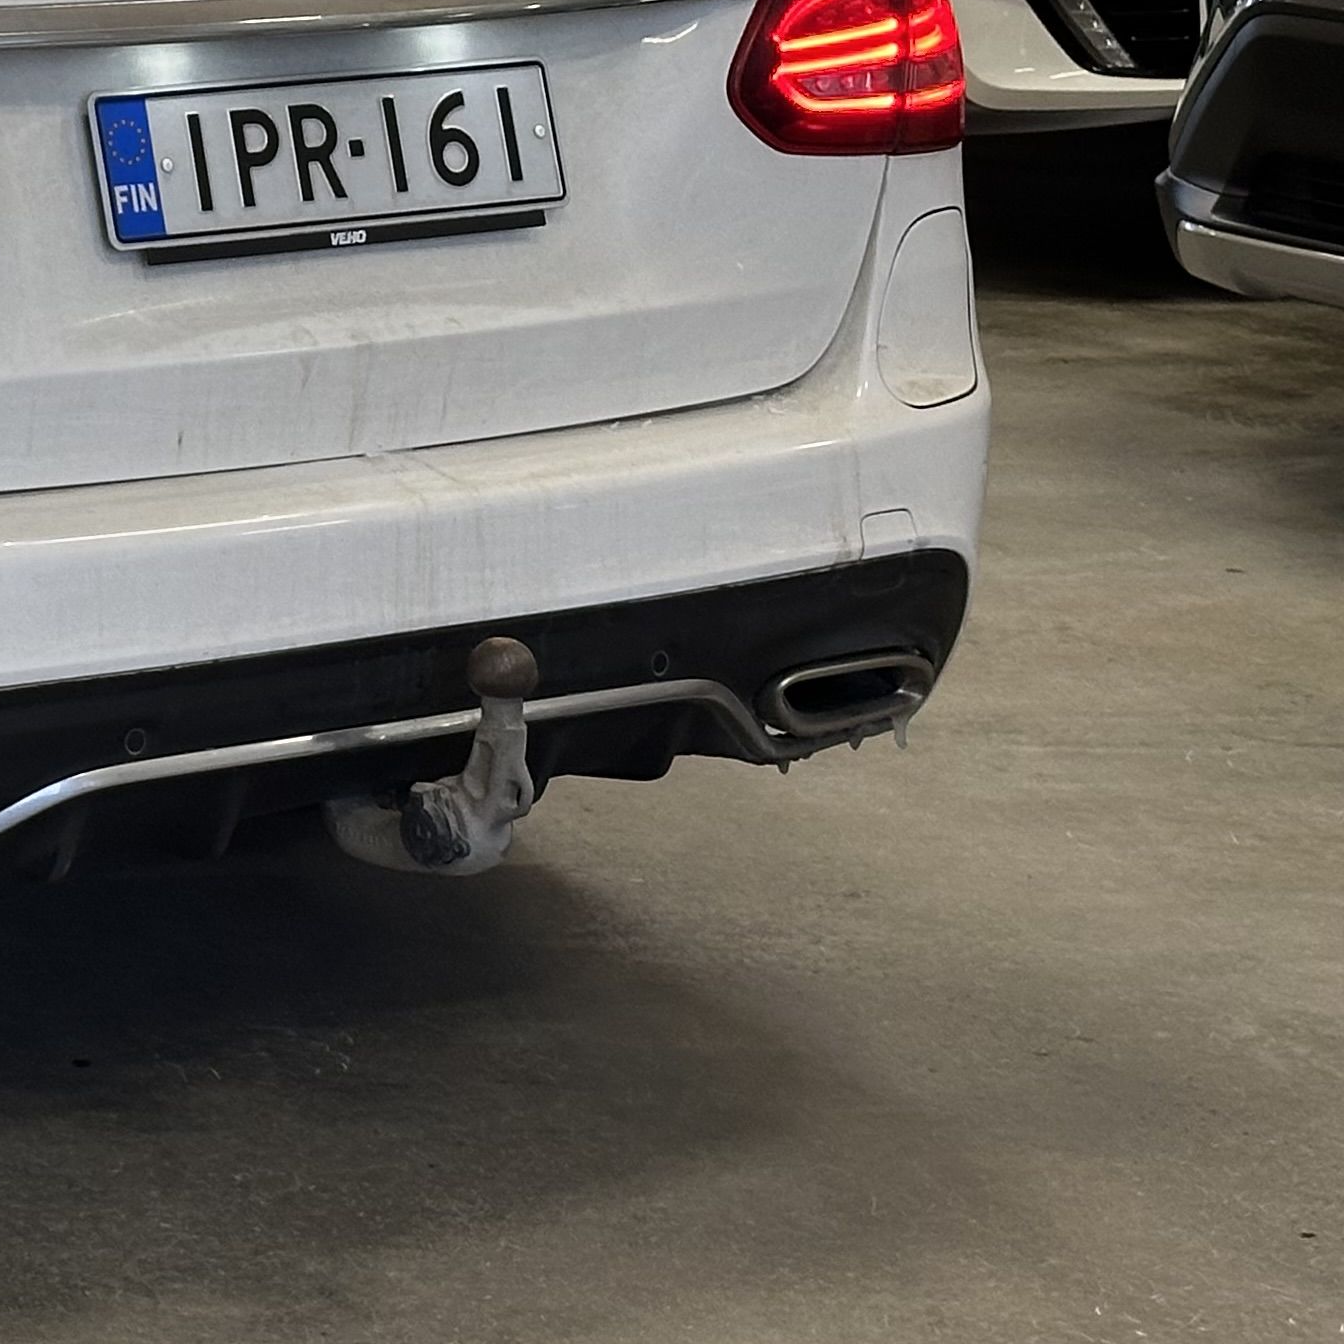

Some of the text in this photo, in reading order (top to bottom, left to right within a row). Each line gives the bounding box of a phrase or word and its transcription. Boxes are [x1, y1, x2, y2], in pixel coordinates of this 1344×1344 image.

[185, 86, 524, 213] IPR-161
[113, 182, 158, 215] FIN
[330, 229, 367, 246] VEHO
